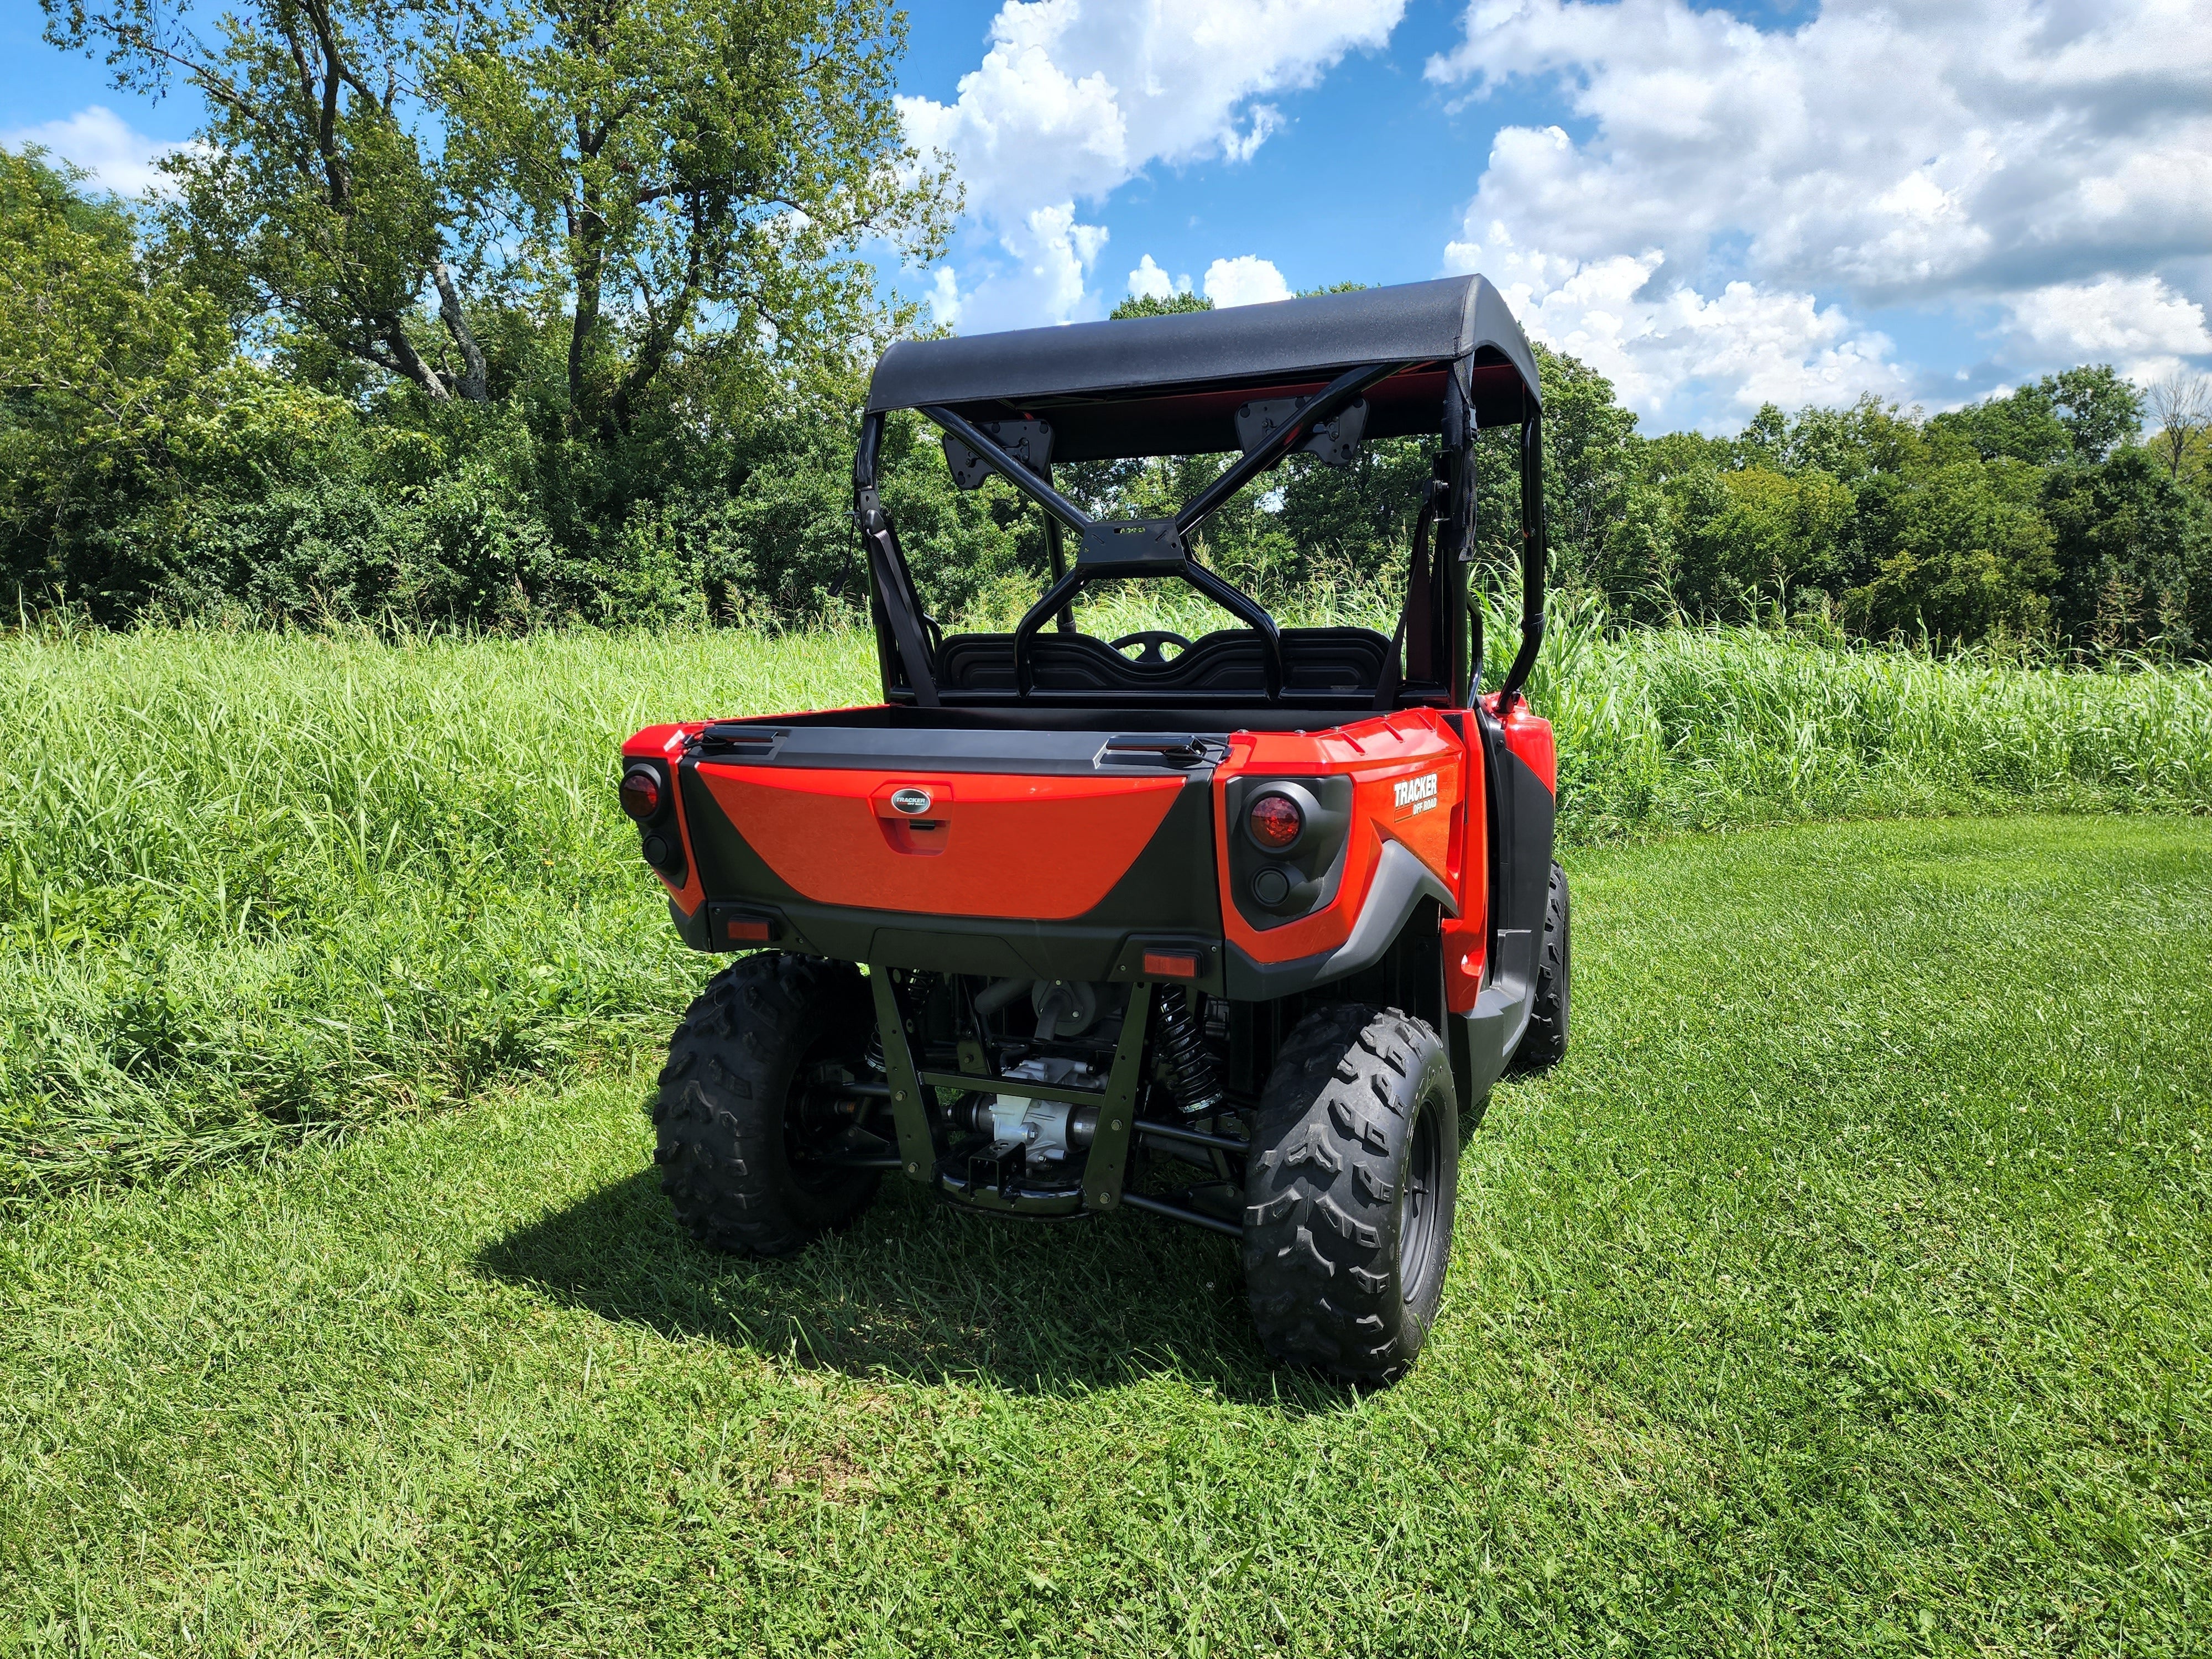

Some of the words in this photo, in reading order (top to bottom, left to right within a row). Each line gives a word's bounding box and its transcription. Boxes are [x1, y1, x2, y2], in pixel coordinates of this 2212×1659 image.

[1394, 773, 1437, 807] TRACKER
[1413, 802, 1423, 816] OFF
[1423, 797, 1437, 811] ROAD
